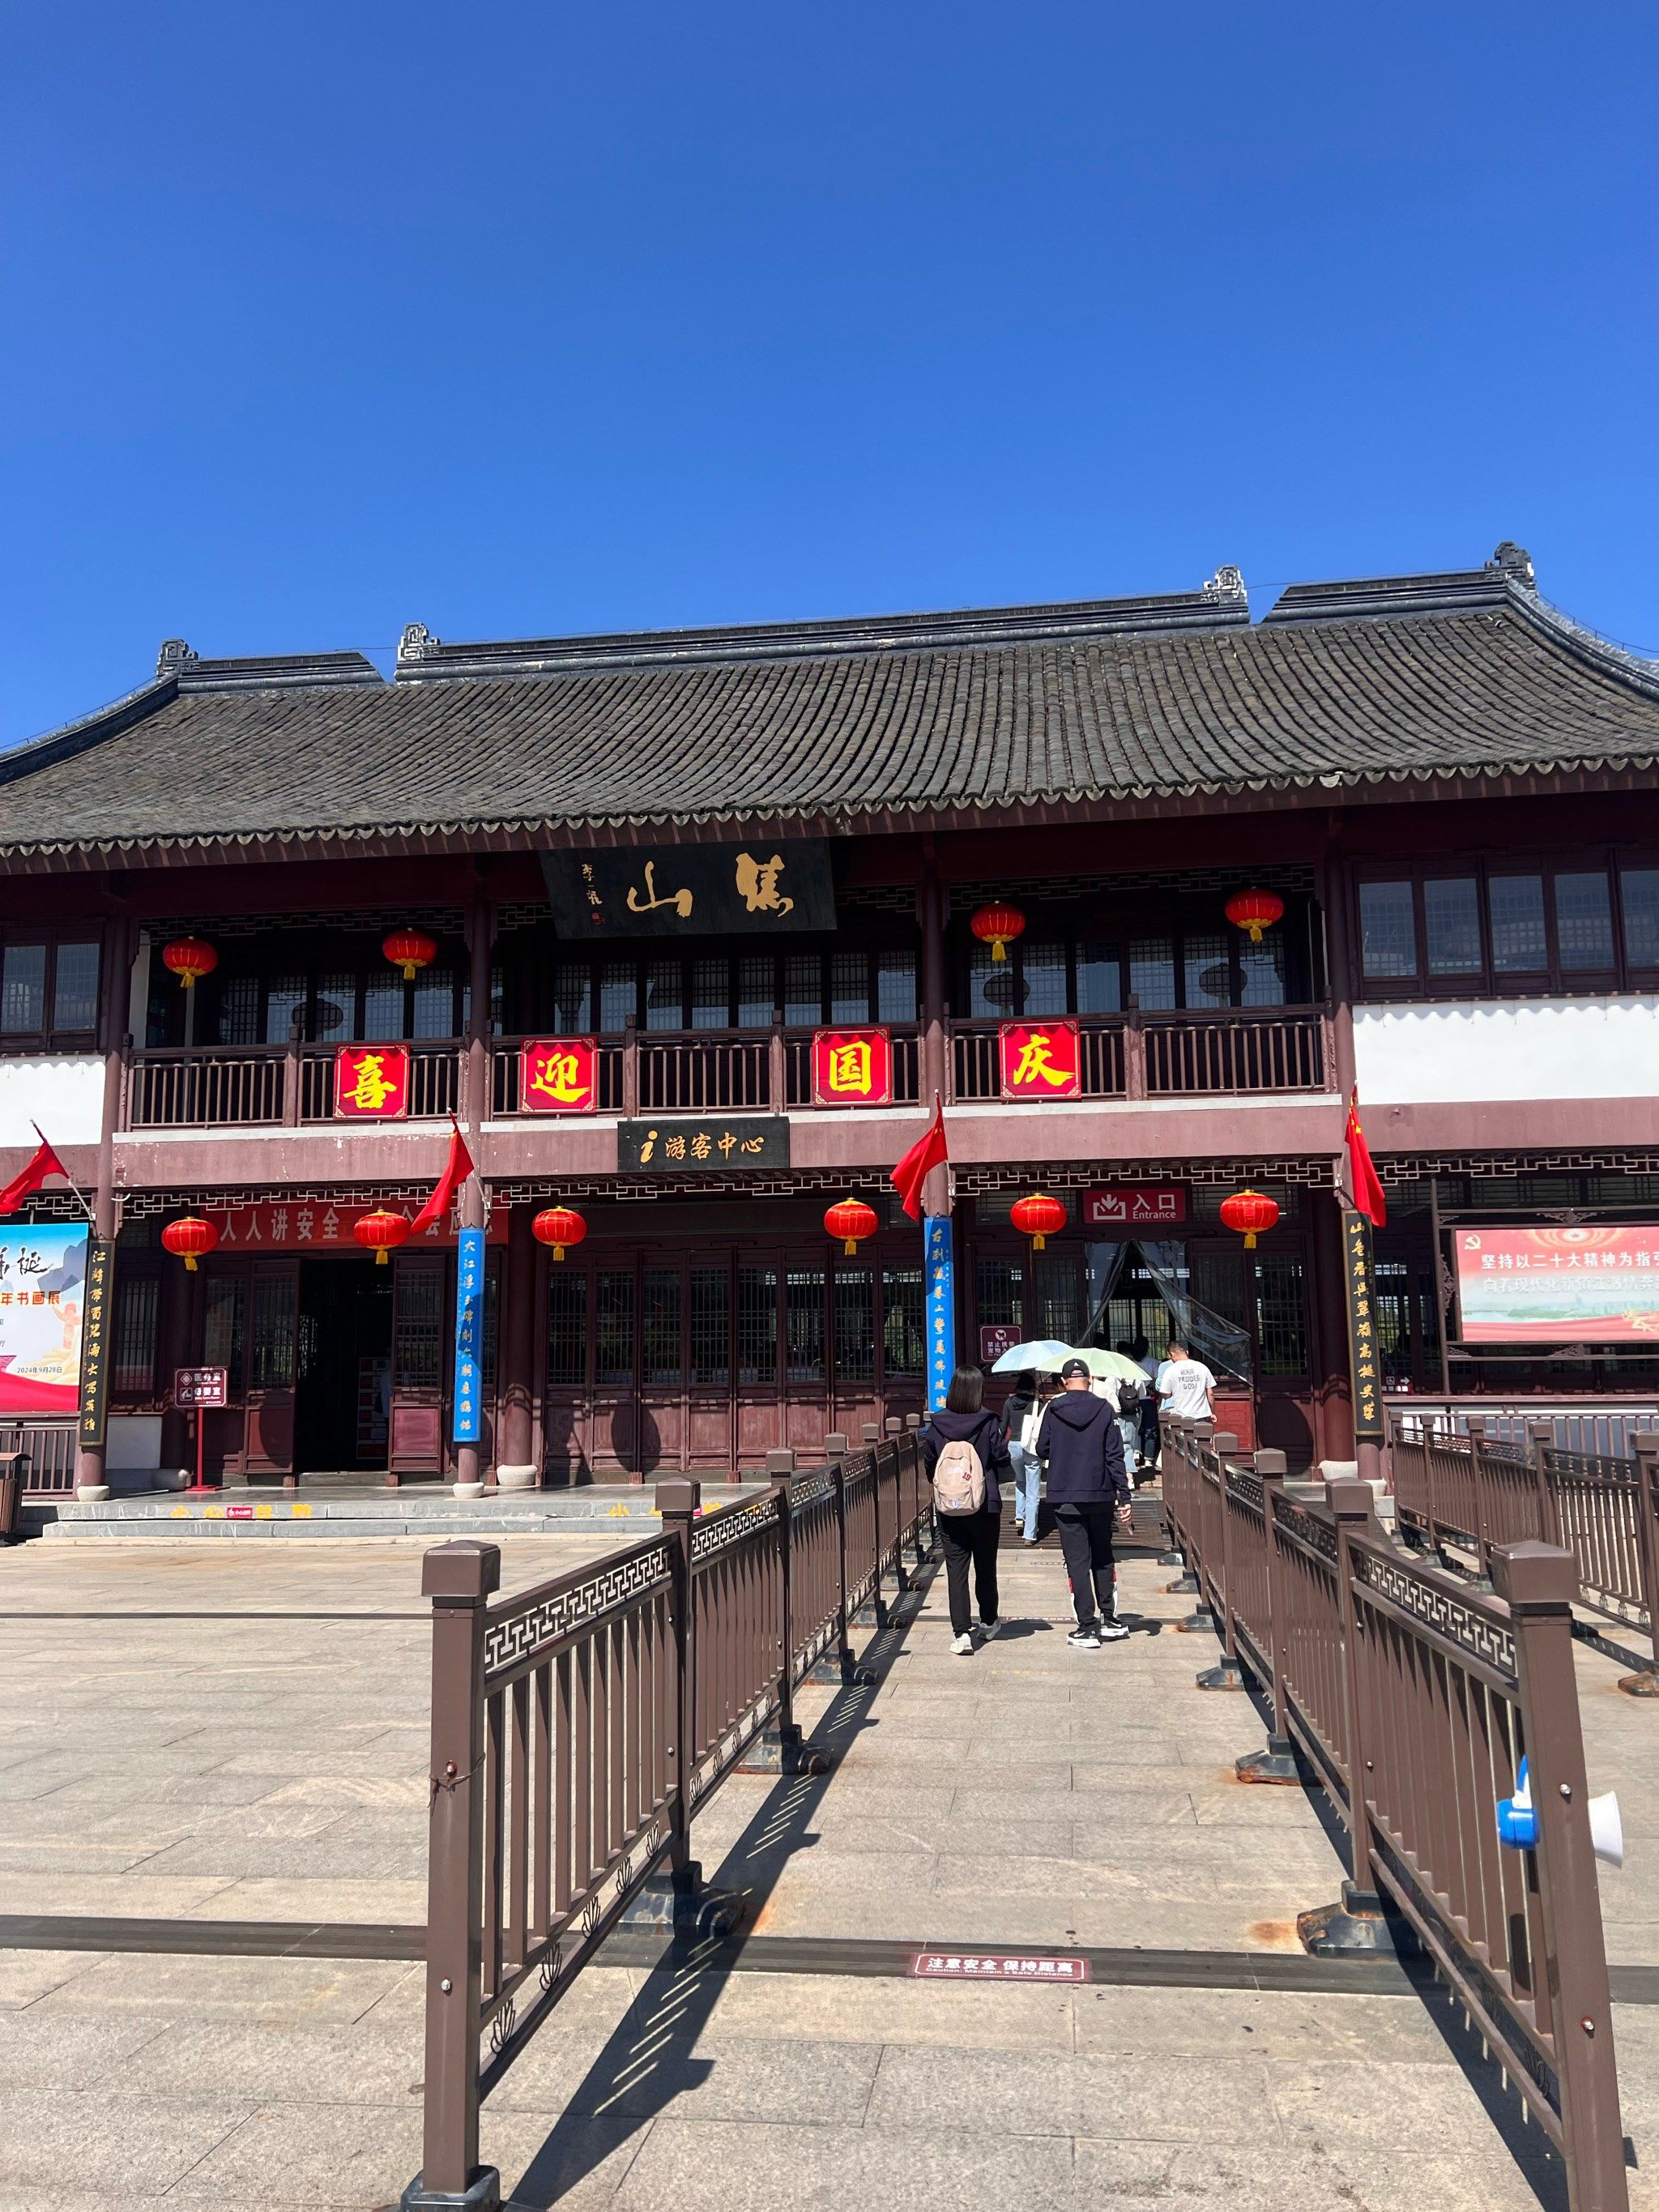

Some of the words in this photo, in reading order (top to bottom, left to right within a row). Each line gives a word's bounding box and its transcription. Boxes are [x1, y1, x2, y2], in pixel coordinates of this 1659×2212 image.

[343, 1054, 397, 1109] 喜
[530, 1053, 591, 1103] 迎
[829, 1040, 872, 1095] 国
[1013, 1033, 1076, 1087] 庆
[665, 1132, 765, 1160] 游客中心
[1132, 1194, 1175, 1211] 入口
[1132, 1211, 1176, 1219] Entrance
[220, 1207, 340, 1242] 人人讲安全
[16, 1366, 63, 1374] 2024年9月28日
[927, 1957, 998, 1971] 注意安全
[1003, 1959, 1073, 1974] 保持距离
